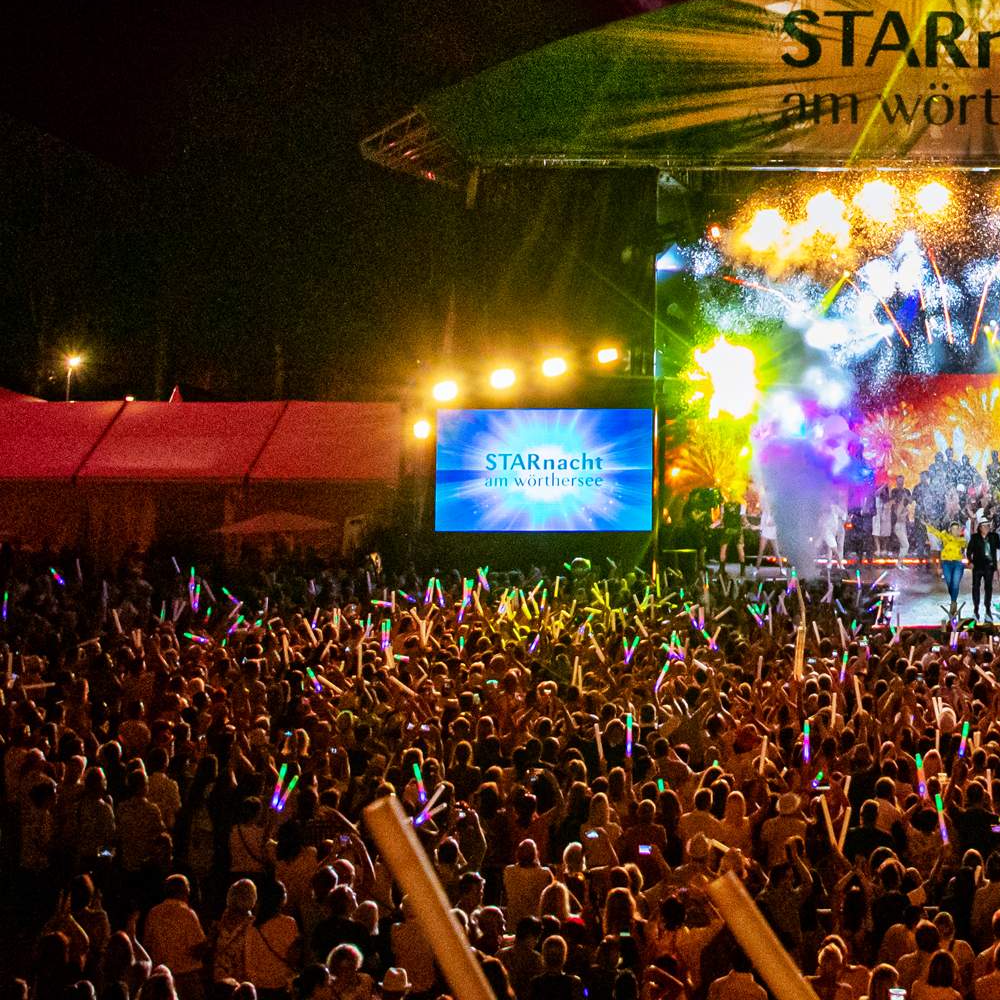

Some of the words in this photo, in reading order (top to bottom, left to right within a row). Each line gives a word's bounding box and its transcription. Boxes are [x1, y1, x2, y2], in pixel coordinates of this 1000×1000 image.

[781, 90, 859, 126] am
[485, 452, 603, 471] STARnacht
[484, 476, 508, 487] am
[514, 473, 604, 487] wörthersee
